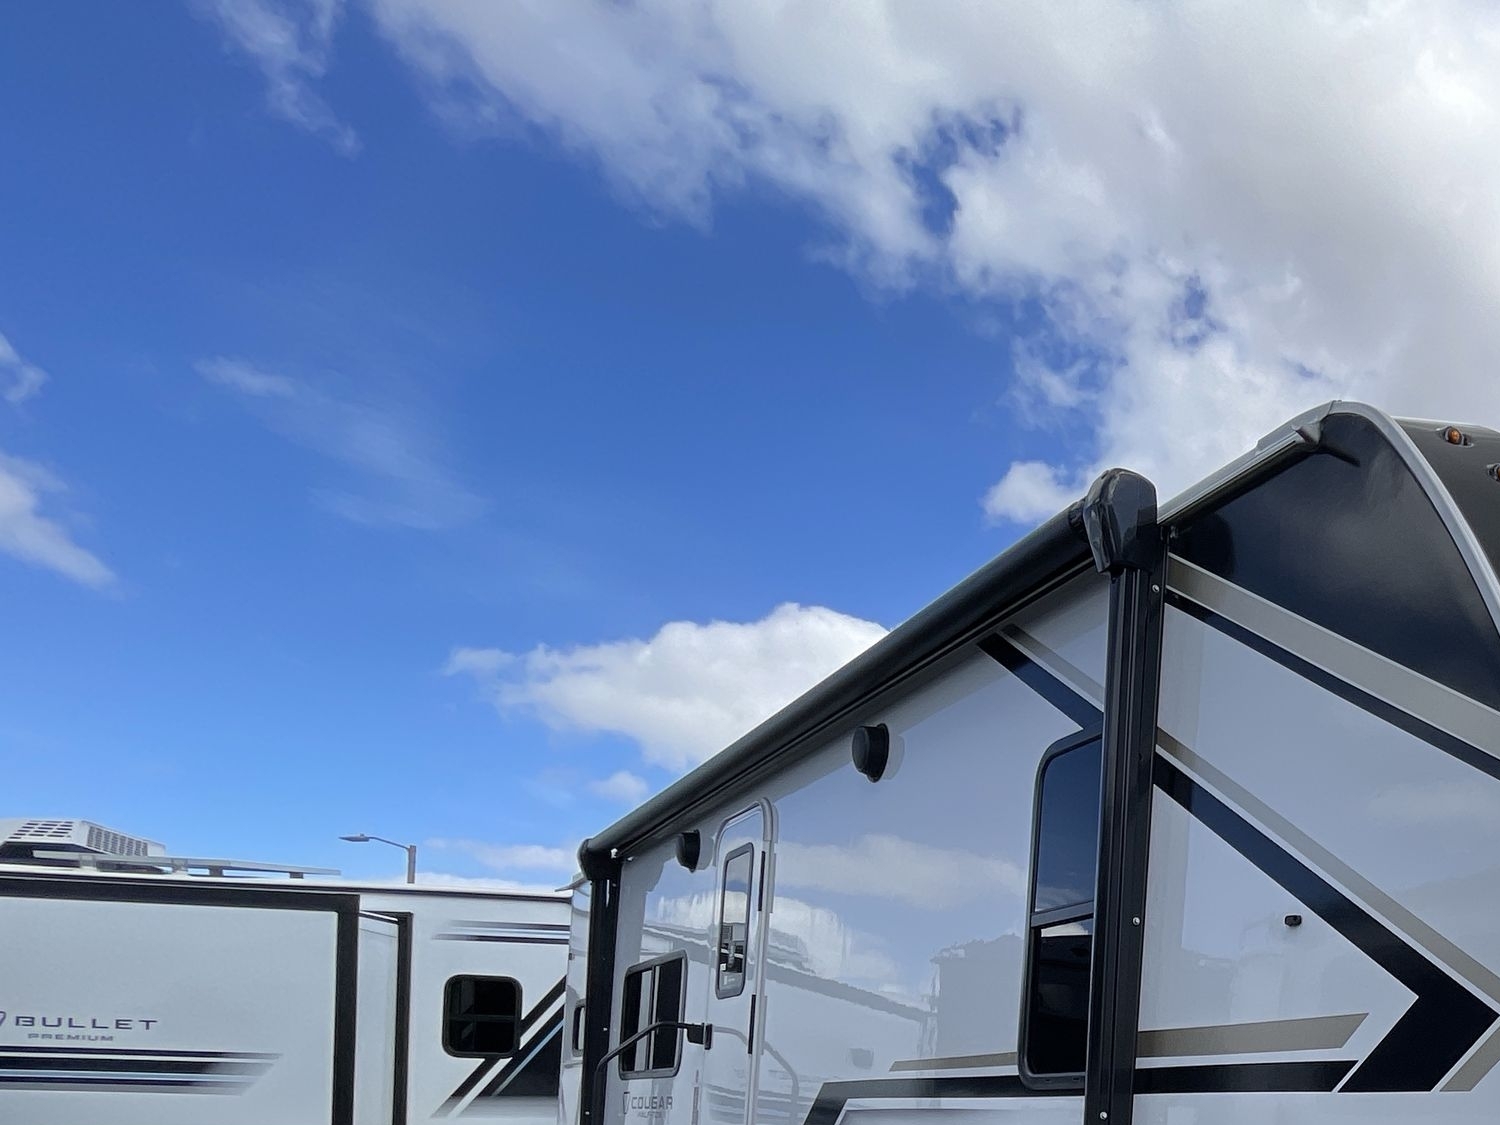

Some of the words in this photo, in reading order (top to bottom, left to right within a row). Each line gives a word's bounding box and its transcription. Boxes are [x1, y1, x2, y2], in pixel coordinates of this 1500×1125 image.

[15, 1016, 158, 1031] BULLET
[28, 1033, 114, 1042] PREMIUM
[631, 1096, 673, 1111] COUGAR
